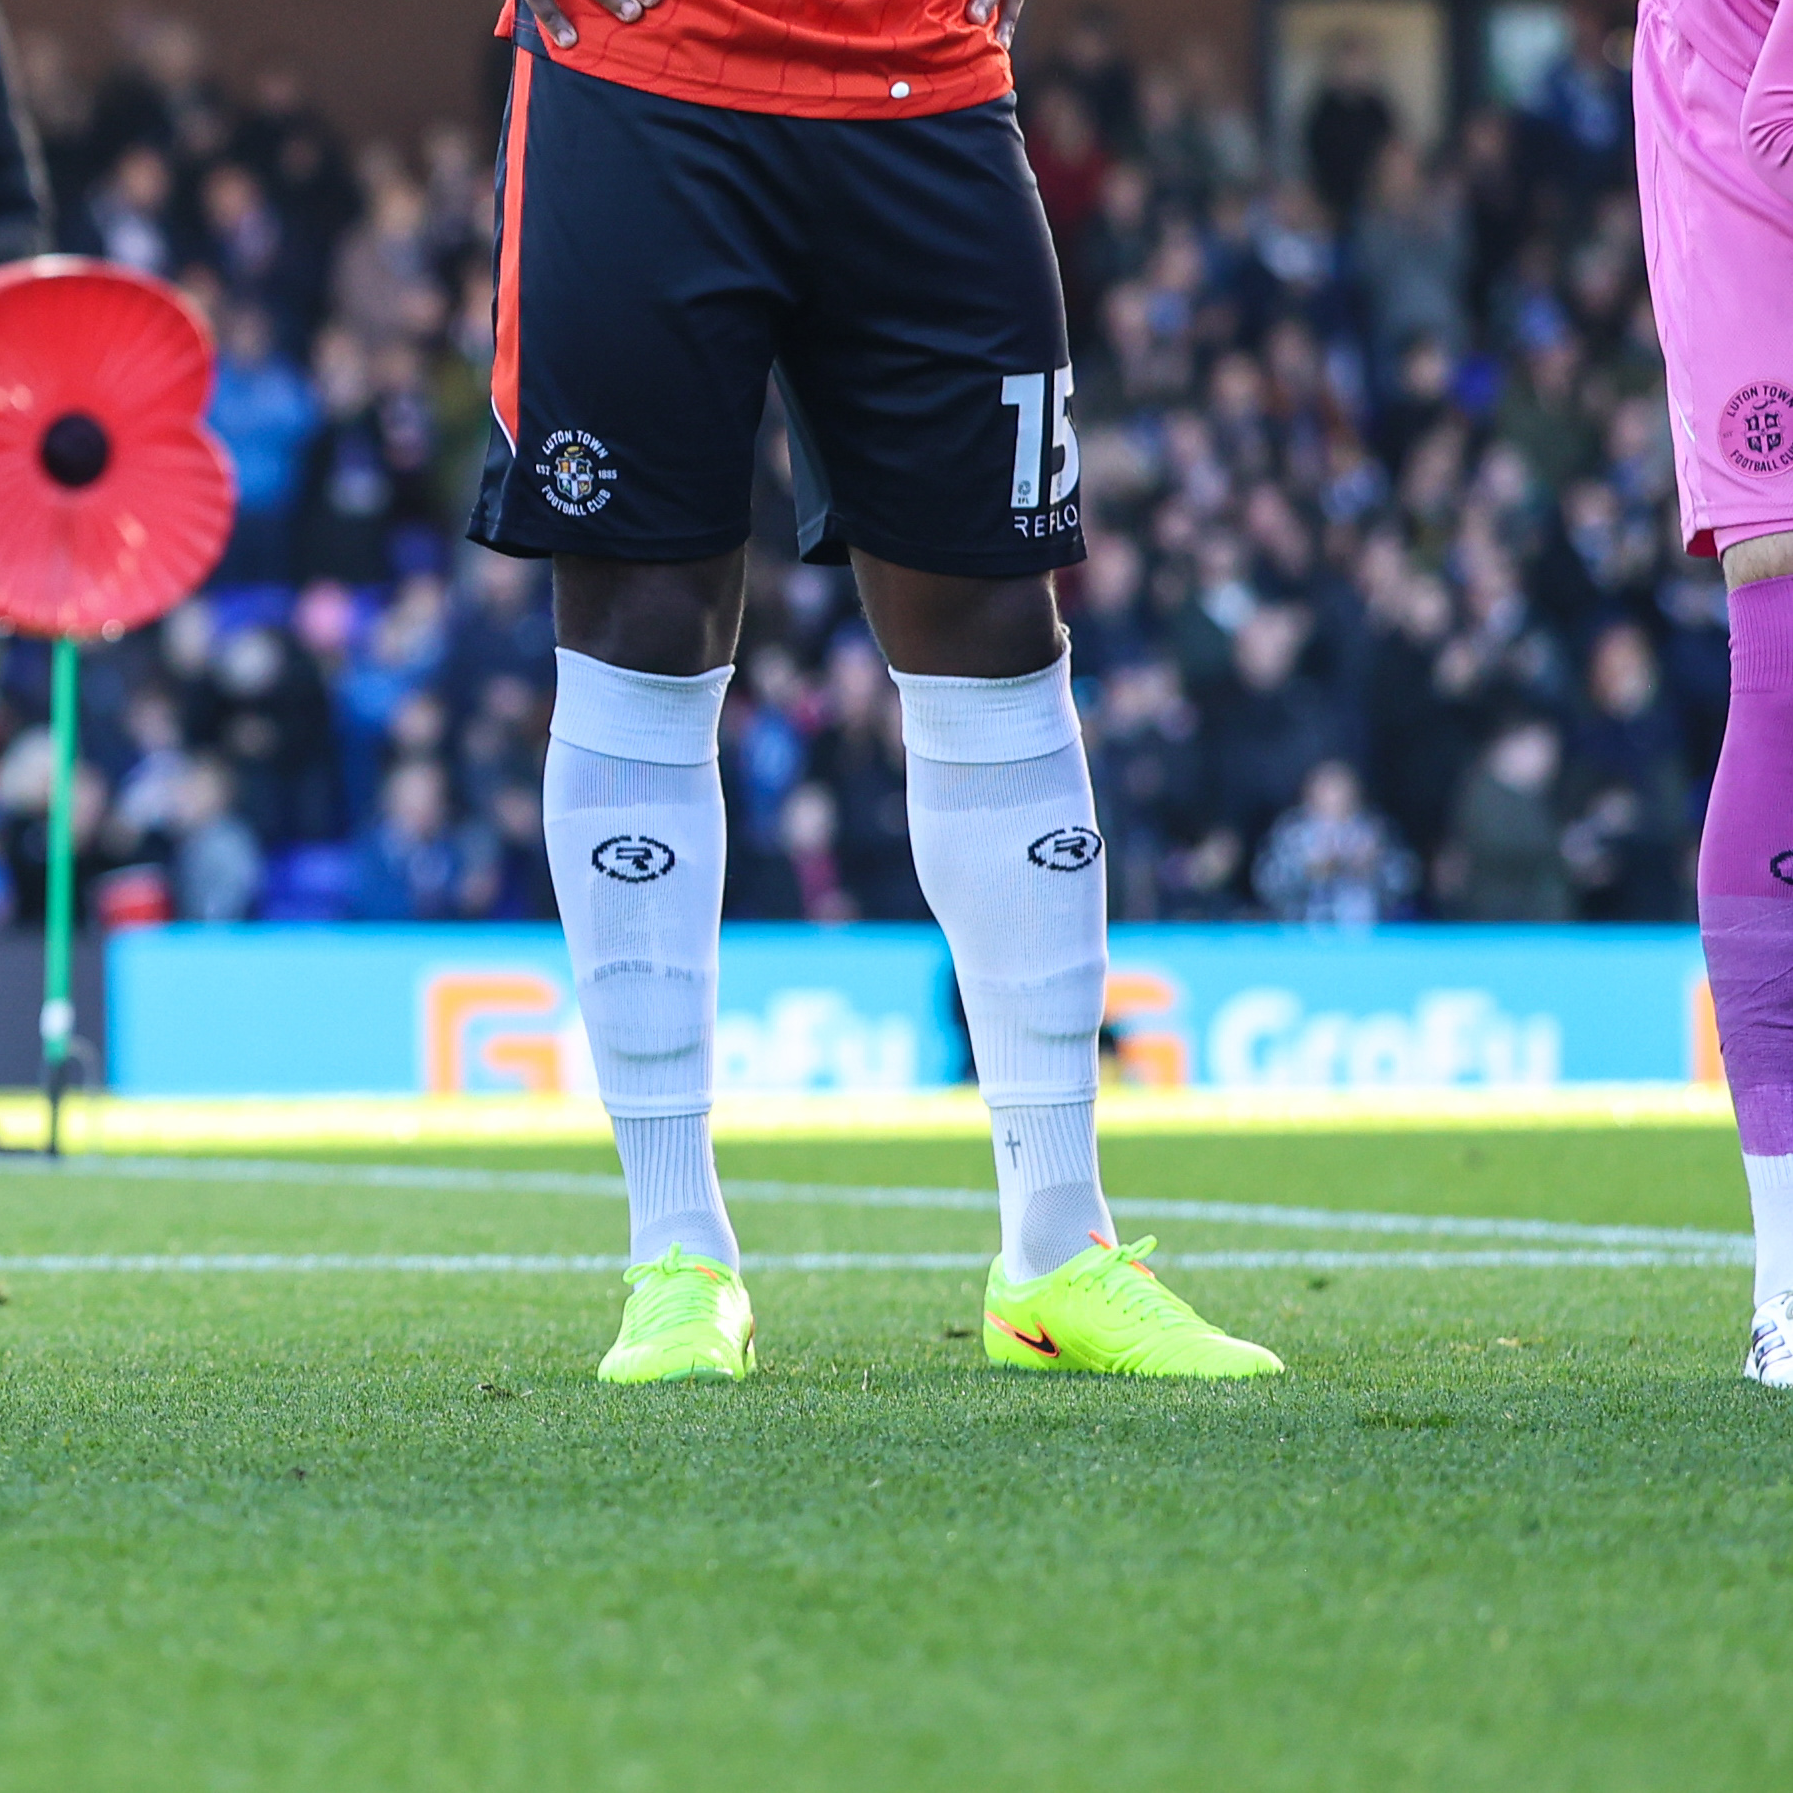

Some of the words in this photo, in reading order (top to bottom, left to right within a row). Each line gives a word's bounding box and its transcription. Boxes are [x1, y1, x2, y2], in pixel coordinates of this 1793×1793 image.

[1726, 386, 1759, 418] LUTON
[541, 429, 573, 455] LUTON
[576, 429, 609, 459] TOWN
[1000, 361, 1081, 509] 15
[535, 463, 550, 476] EST
[1730, 448, 1779, 472] FOOTBALL
[541, 484, 587, 516] FOOTBALL
[586, 488, 611, 513] CLUB
[1014, 503, 1079, 539] REFLO
